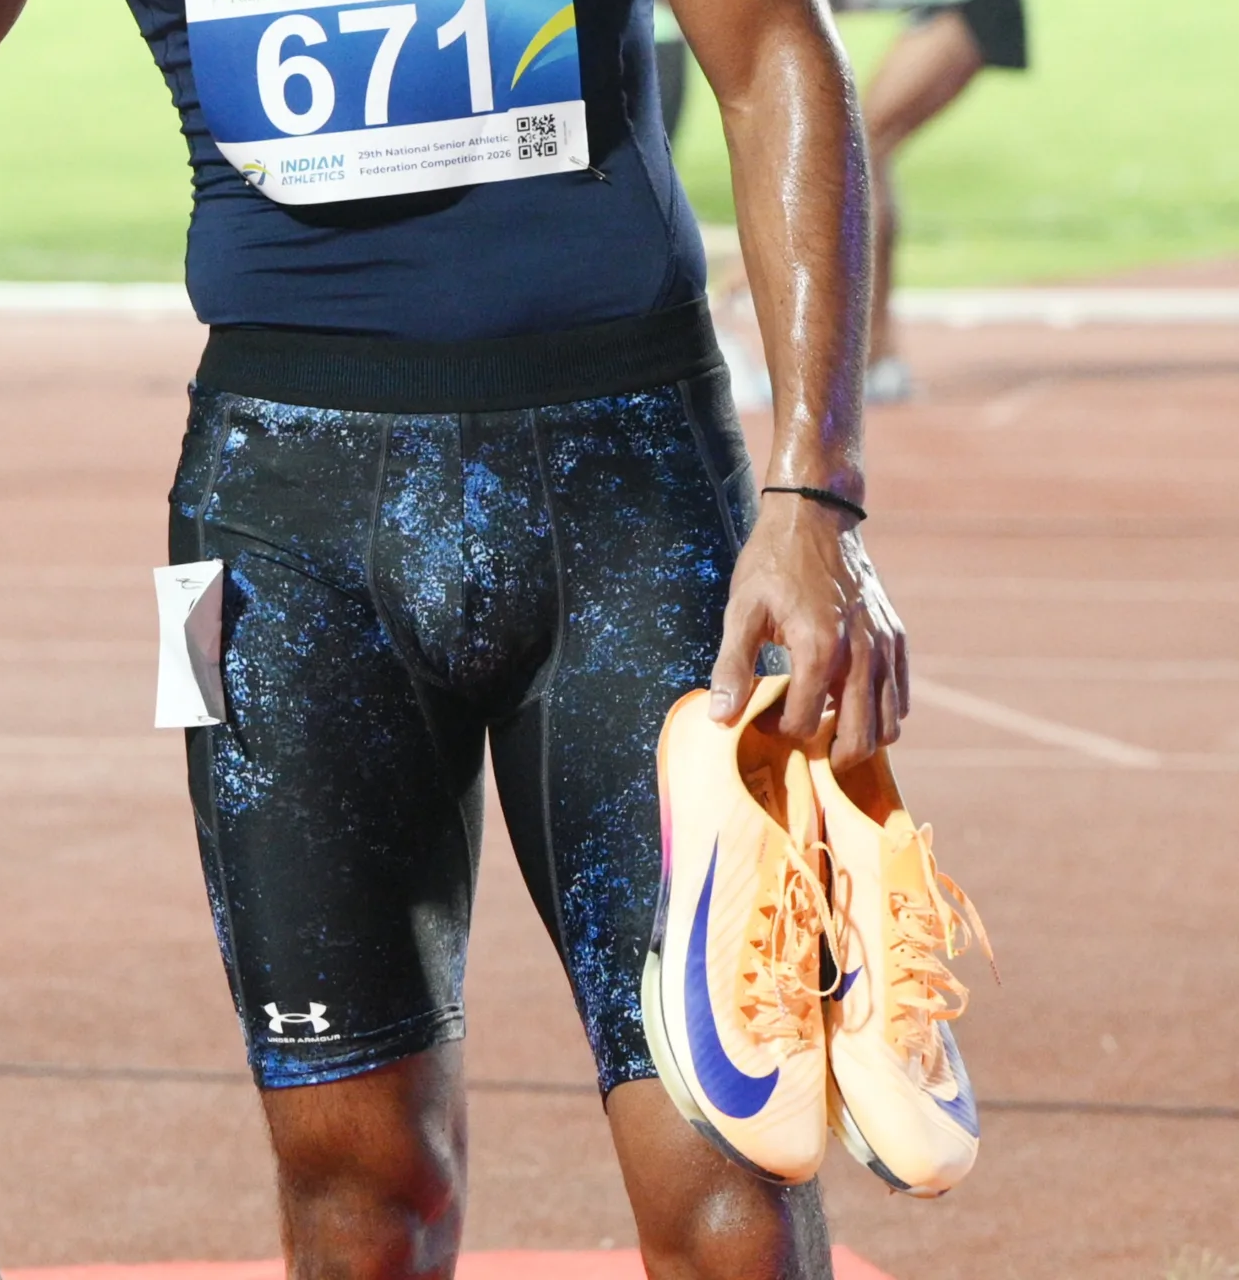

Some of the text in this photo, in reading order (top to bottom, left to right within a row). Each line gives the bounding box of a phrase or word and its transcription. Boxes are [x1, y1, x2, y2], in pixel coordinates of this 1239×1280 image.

[358, 134, 509, 160] 29th National Senior Athletic
[280, 154, 344, 174] INDIAN
[360, 149, 512, 176] Federation Competition 2026
[281, 170, 345, 186] ATHLETICS
